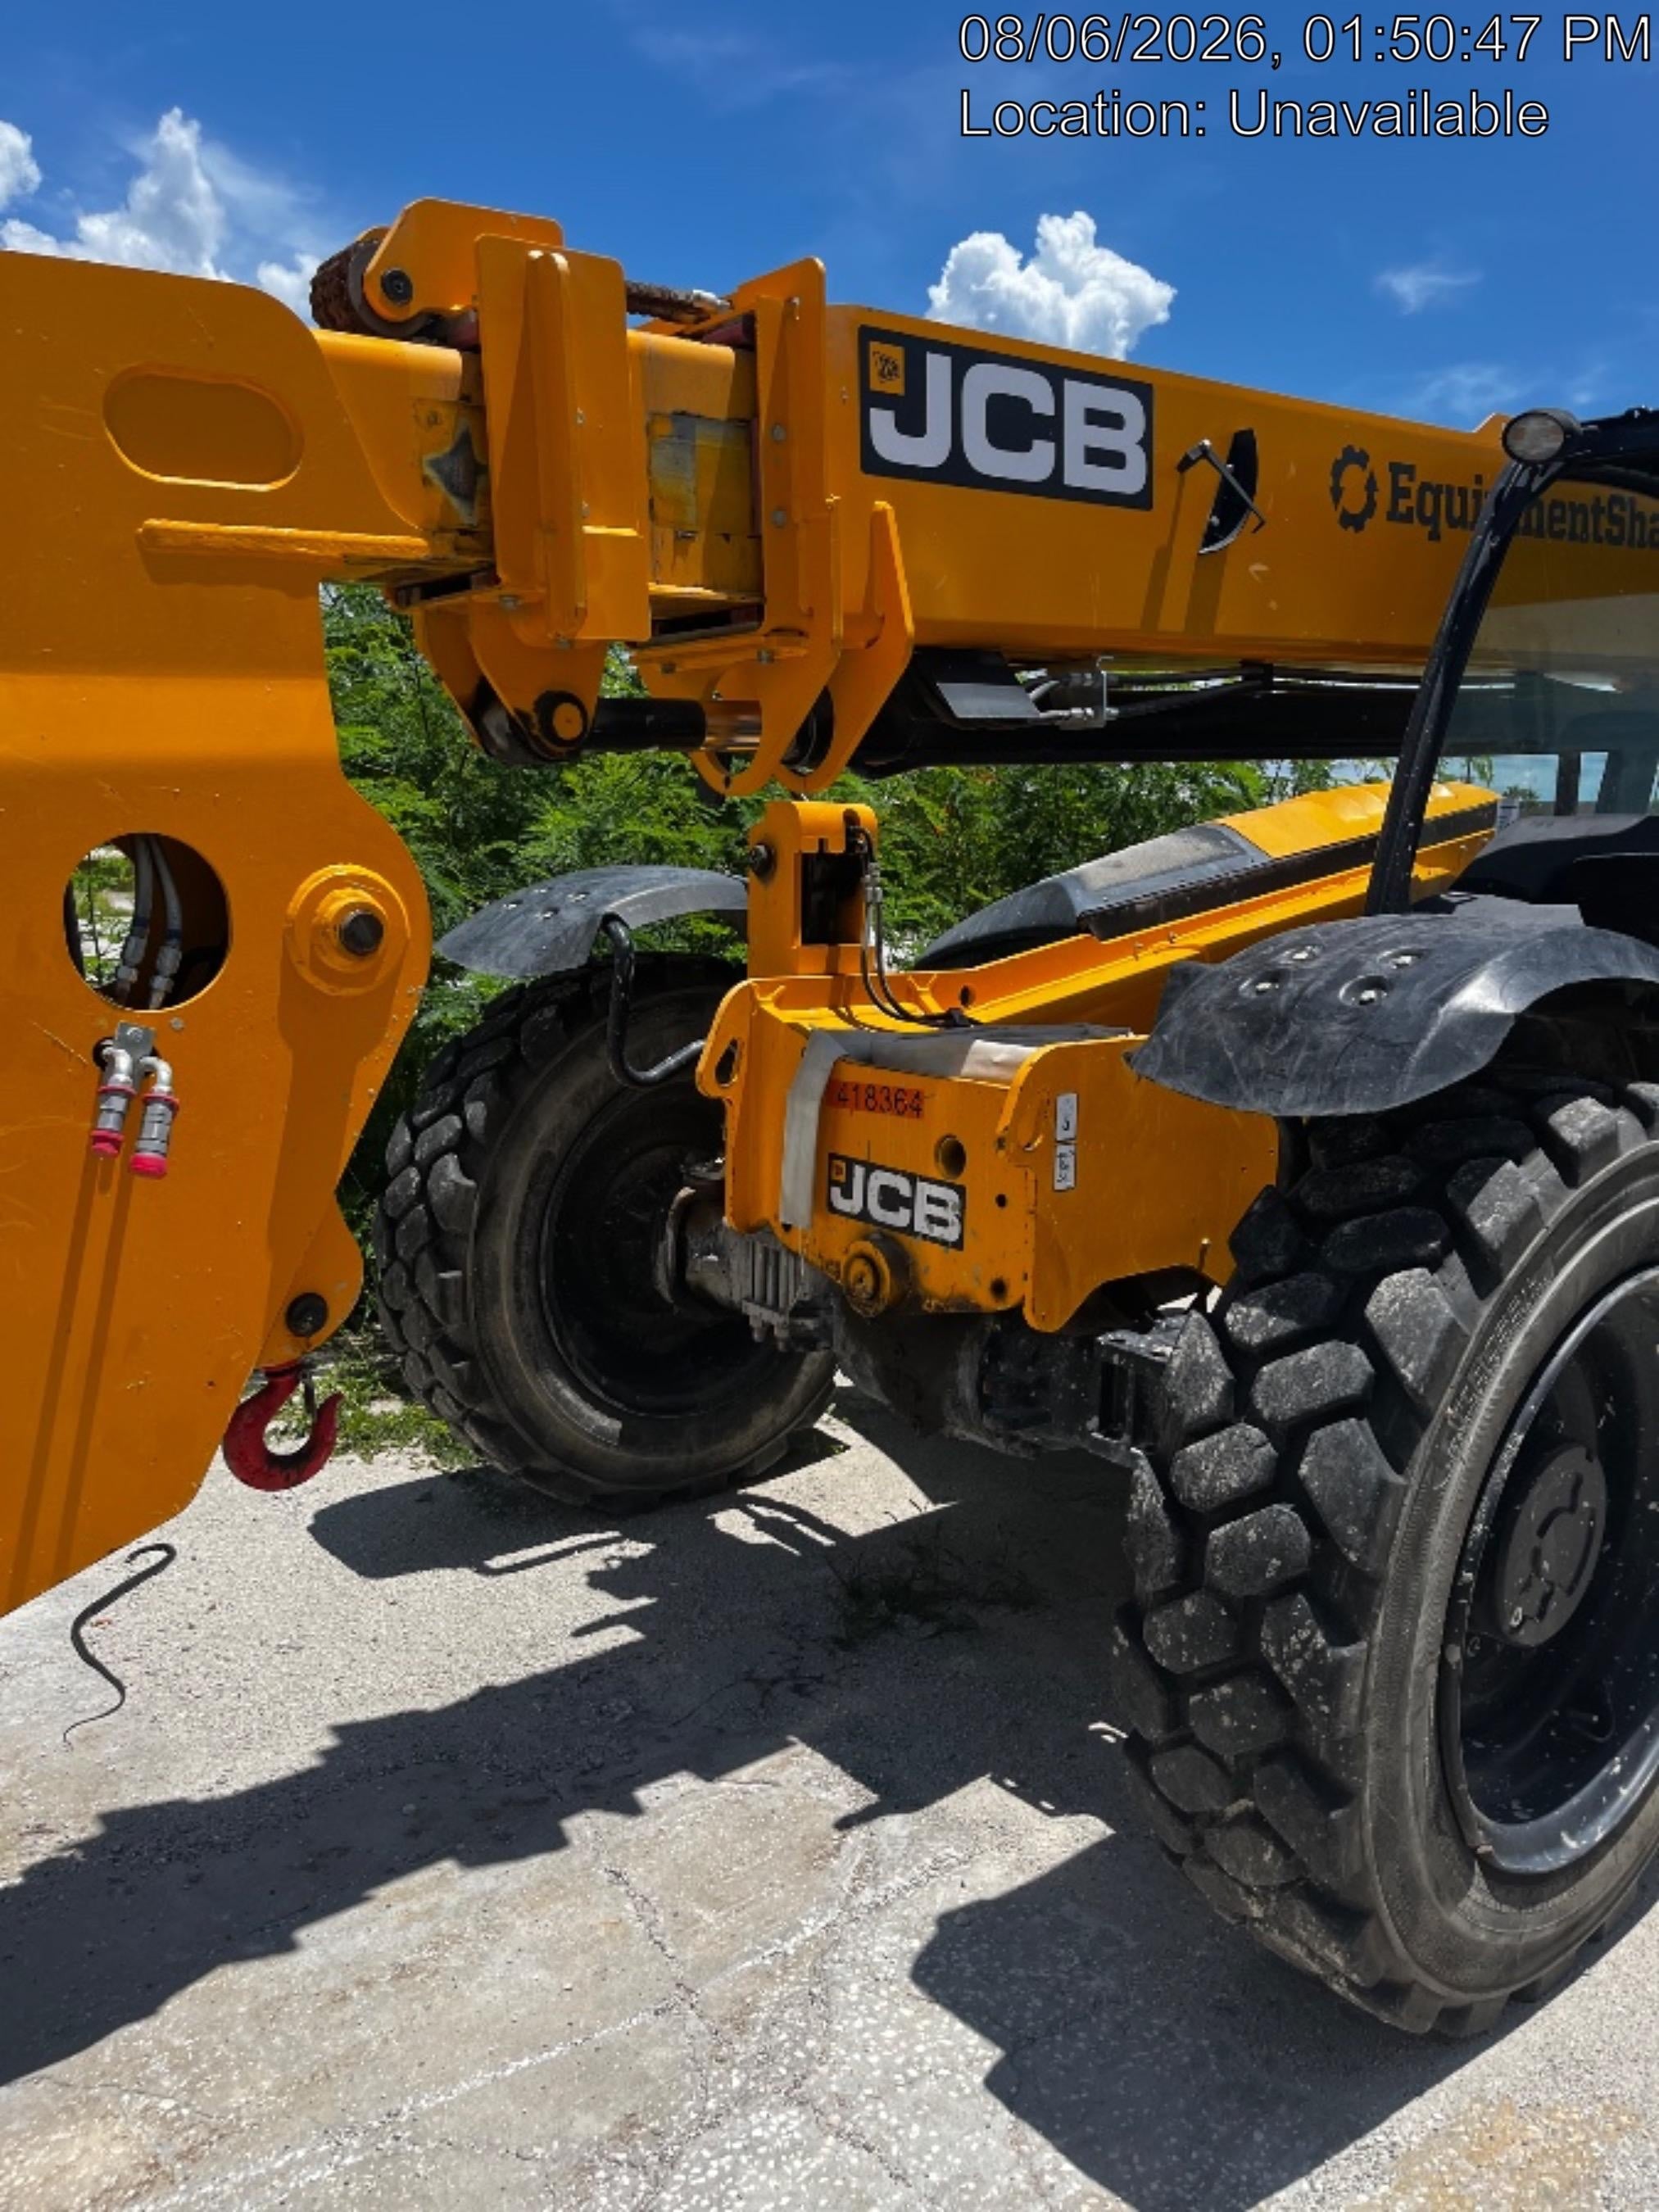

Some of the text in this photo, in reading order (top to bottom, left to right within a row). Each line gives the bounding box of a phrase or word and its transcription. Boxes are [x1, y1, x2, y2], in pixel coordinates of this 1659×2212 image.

[869, 351, 1147, 494] JCB
[837, 1083, 922, 1118] 418364
[830, 1163, 962, 1242] JCB
